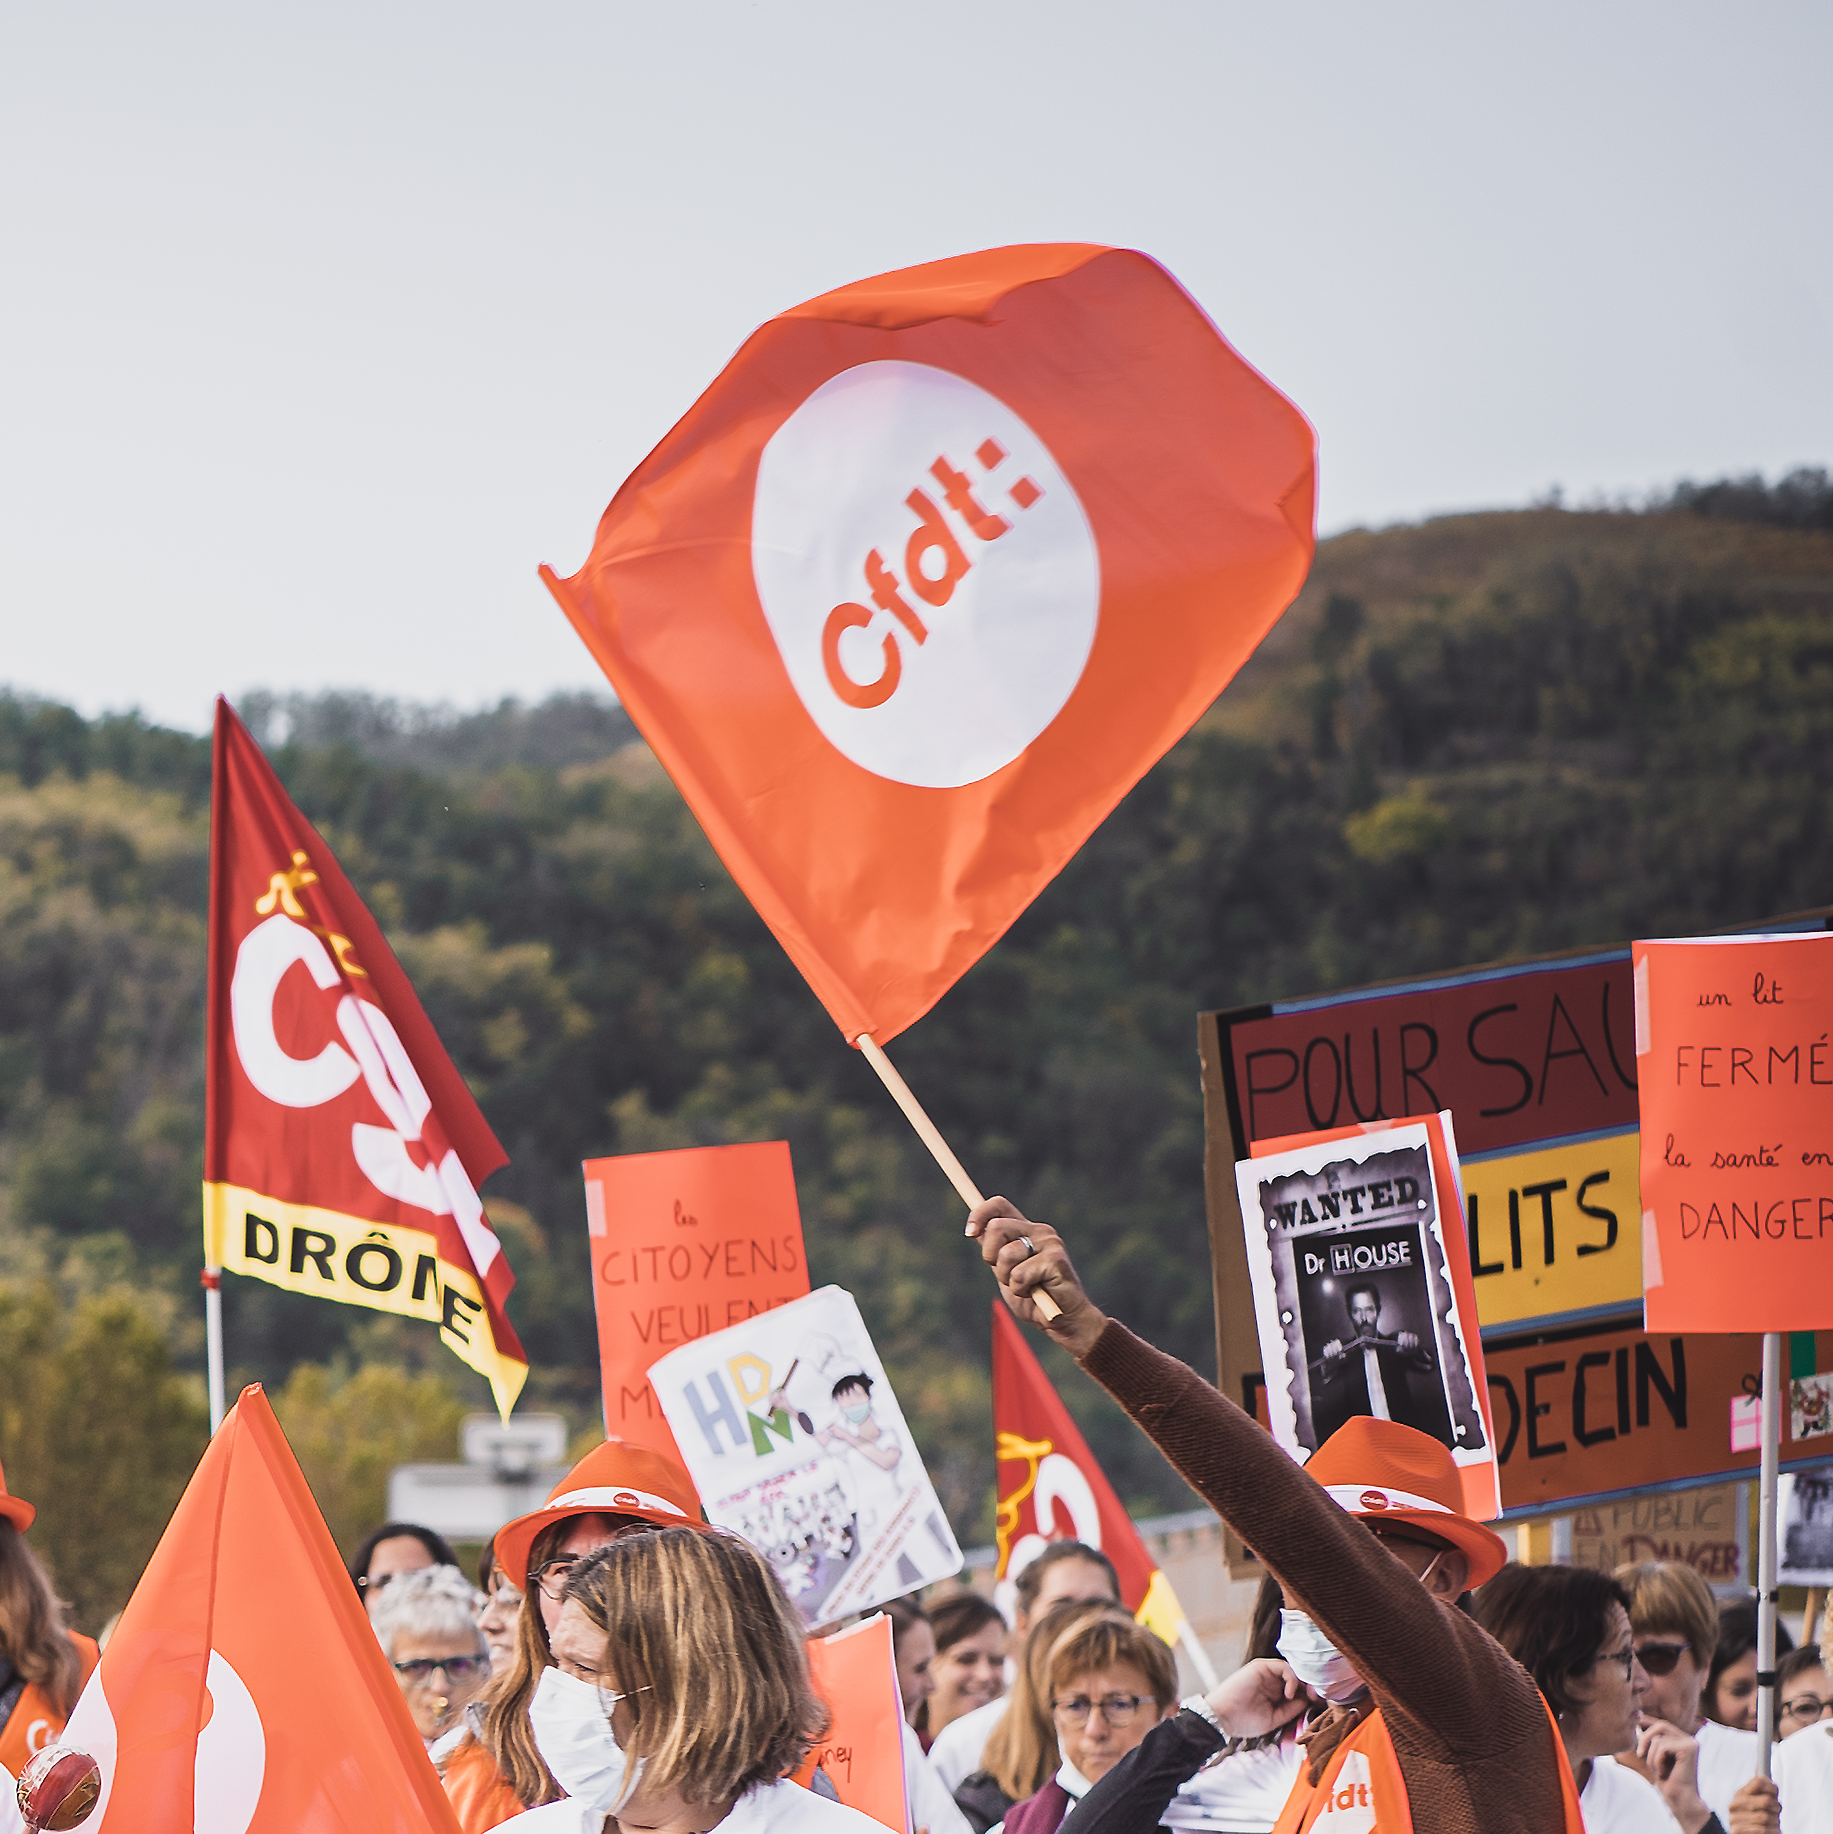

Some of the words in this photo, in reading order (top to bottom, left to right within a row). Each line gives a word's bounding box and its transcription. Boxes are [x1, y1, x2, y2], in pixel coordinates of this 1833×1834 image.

[1697, 992, 1733, 1007] un
[1752, 972, 1784, 1005] lit
[1245, 1022, 1440, 1141] POUR
[1677, 1032, 1833, 1088] FERMÉ
[1664, 1132, 1692, 1168] la
[1710, 1143, 1783, 1169] santé
[1274, 1175, 1420, 1230] WANTED
[1467, 1170, 1620, 1279] LITS
[1679, 1198, 1833, 1240] DANGER
[600, 1235, 799, 1287] CITOYENS
[1304, 1252, 1326, 1275] Dr
[1331, 1241, 1411, 1273] HOUSE
